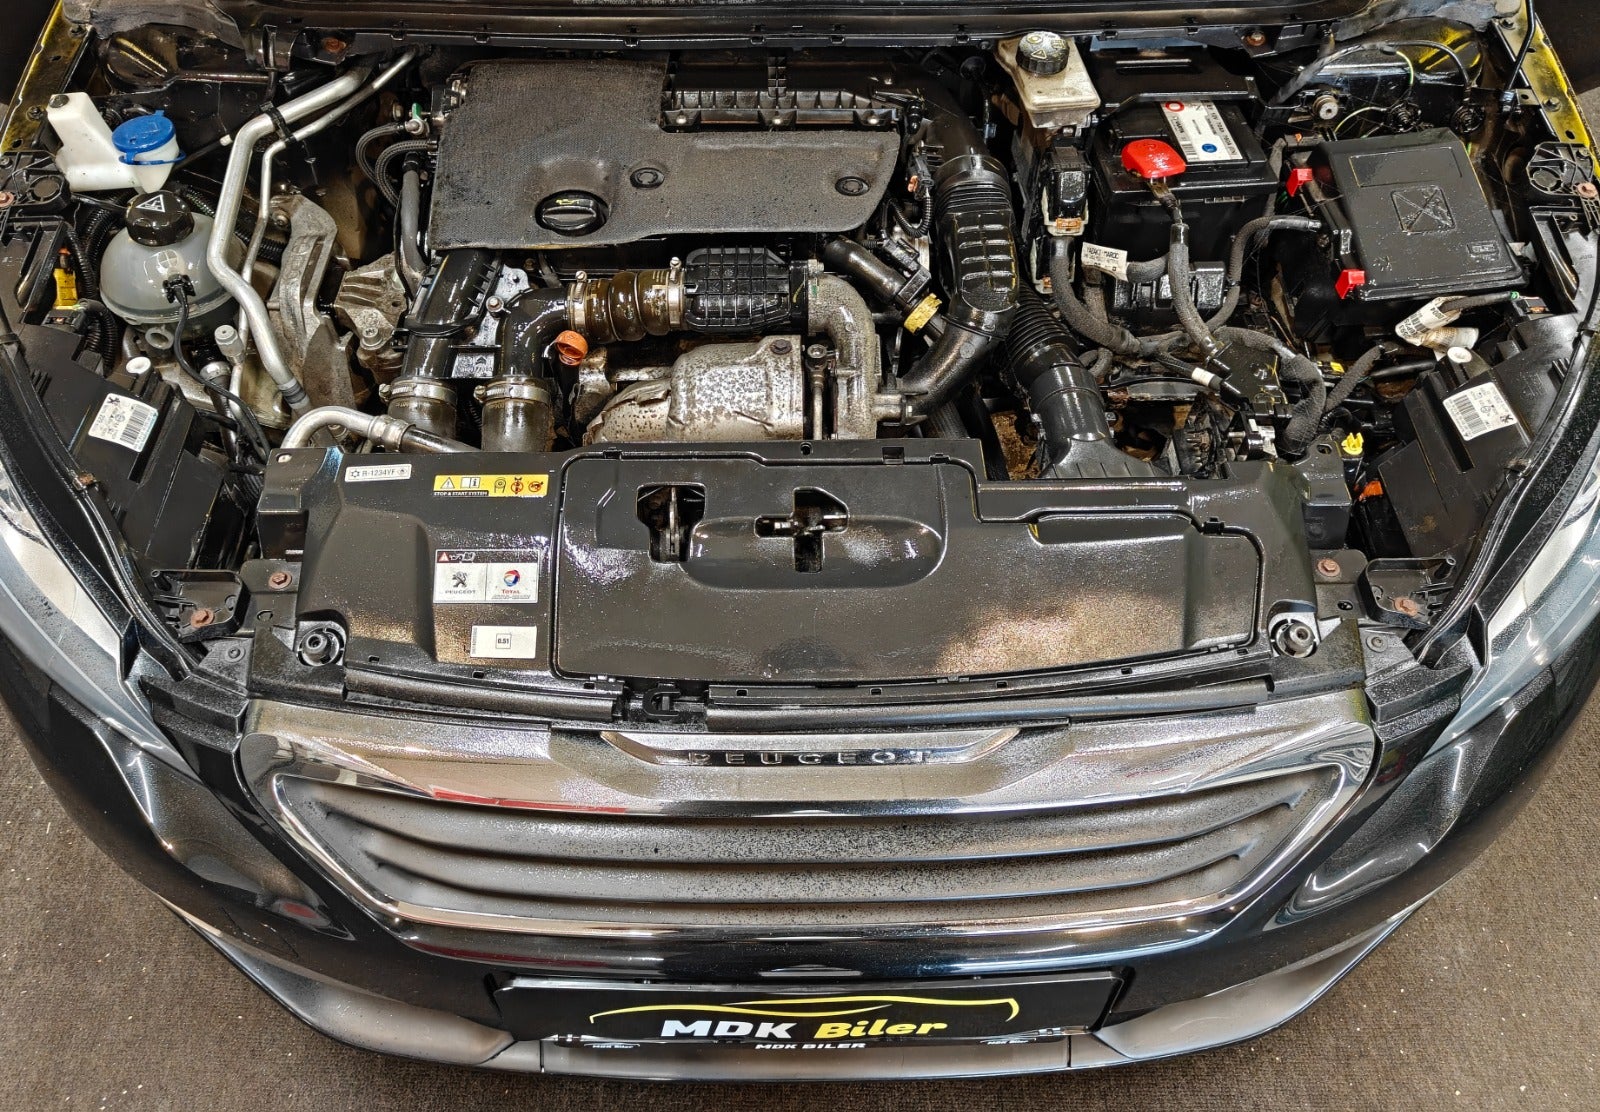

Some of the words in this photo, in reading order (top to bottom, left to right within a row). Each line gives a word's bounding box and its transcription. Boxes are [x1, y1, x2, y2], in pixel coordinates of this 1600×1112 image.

[688, 750, 930, 765] PEUGEOT
[660, 1019, 797, 1039] MDK
[813, 1018, 948, 1039] Biler
[802, 1042, 867, 1050] BILER
